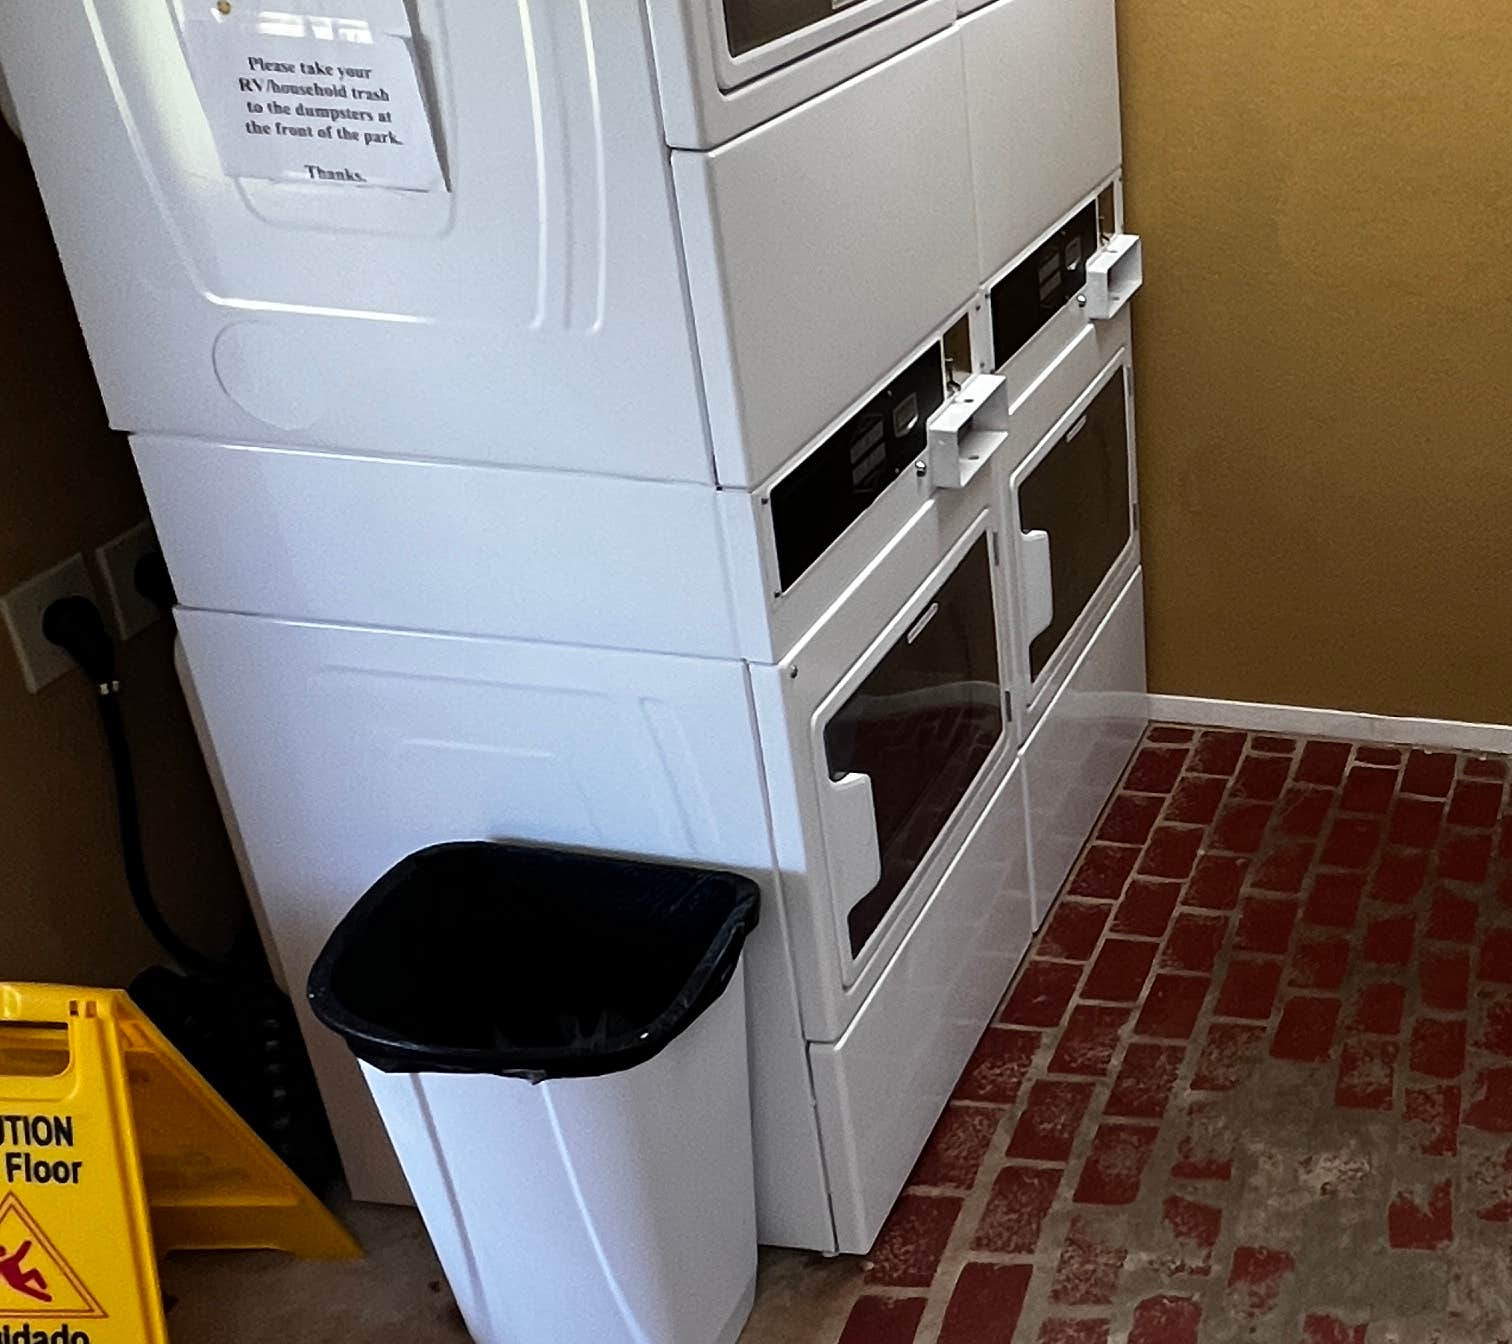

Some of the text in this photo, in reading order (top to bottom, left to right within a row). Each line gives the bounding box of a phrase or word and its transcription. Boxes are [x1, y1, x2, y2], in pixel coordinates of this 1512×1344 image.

[248, 56, 372, 81] Please take your
[238, 77, 390, 102] RV/household trash
[246, 101, 392, 123] to the dumpsters at
[245, 120, 404, 145] the front of the park.
[304, 165, 367, 182] Thanks.
[5, 1151, 82, 1184] Floor
